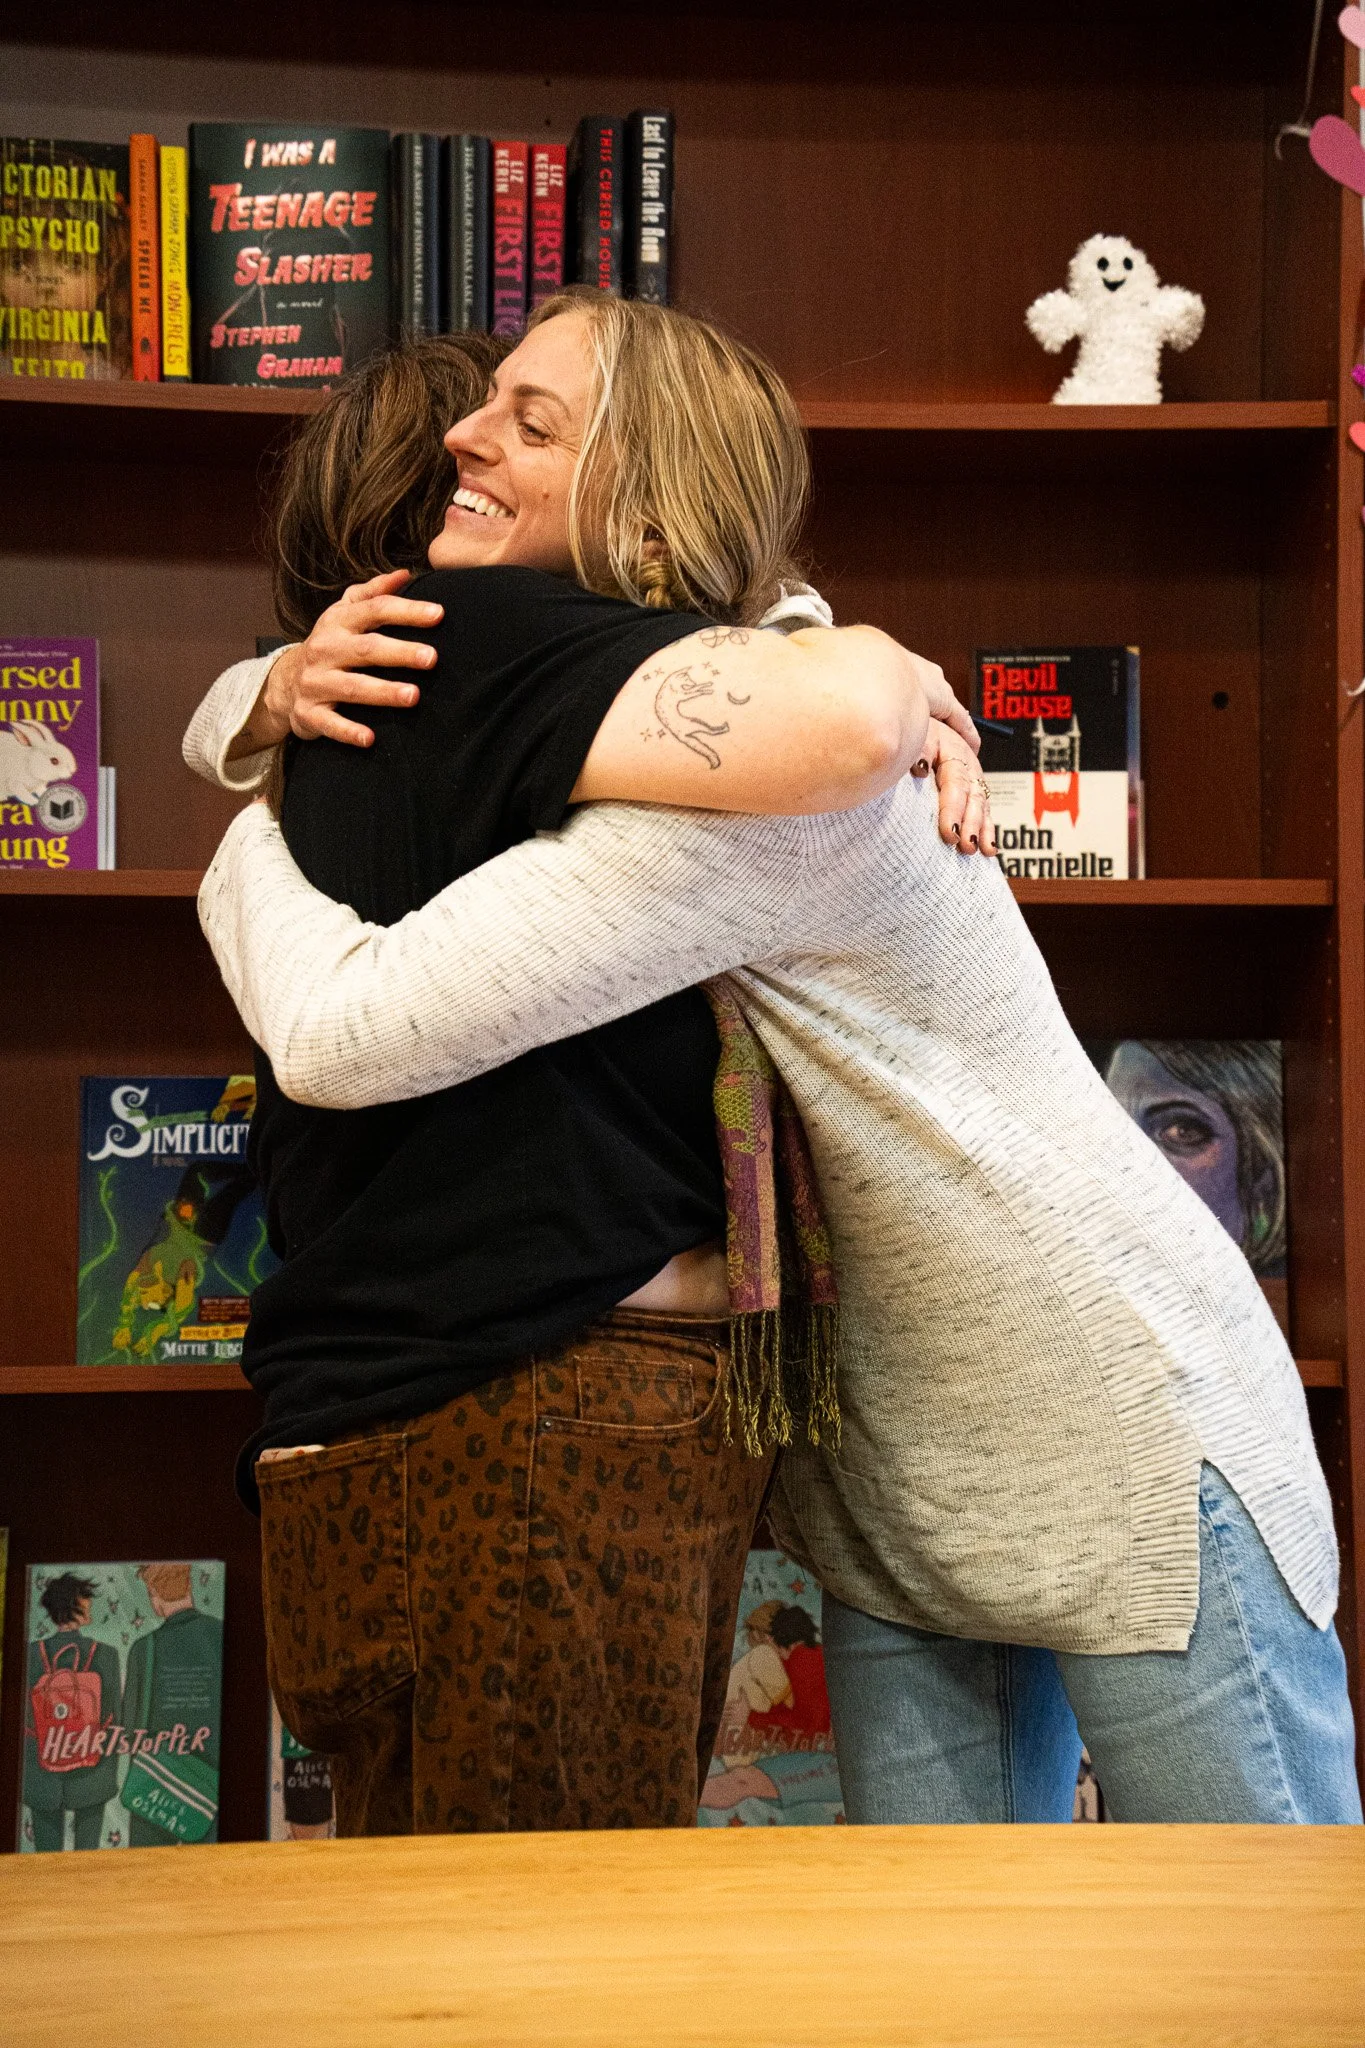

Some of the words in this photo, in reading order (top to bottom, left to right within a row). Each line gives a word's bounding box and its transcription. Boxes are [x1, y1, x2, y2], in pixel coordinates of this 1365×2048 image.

[600, 128, 613, 162] THIS
[642, 116, 667, 143] Last
[244, 138, 257, 169] I
[261, 140, 315, 167] WAS
[318, 138, 337, 165] A
[495, 149, 509, 193] KERIN
[642, 147, 666, 159] to
[509, 160, 524, 184] LIZ
[534, 153, 548, 197] KERIN
[549, 164, 563, 187] LIZ
[641, 162, 666, 198] Leave
[209, 182, 377, 233] TEENAGE
[599, 168, 613, 230] CURSED
[641, 202, 666, 223] the
[0, 215, 99, 254] PSYCHO
[494, 198, 524, 282] FIRST
[533, 202, 562, 285] FIRST
[640, 227, 666, 263] Room
[138, 240, 151, 289] SPREAD
[233, 246, 374, 286] SLASHER
[599, 237, 612, 289] HOUSE
[139, 297, 152, 314] ME
[166, 279, 184, 365] MONGRELS
[210, 323, 302, 349] STEPHEN
[256, 353, 343, 379] GRAHAM
[981, 662, 1057, 691] Devil
[983, 689, 1072, 719] House
[42, 1723, 211, 1763] HEARTSTOPPER
